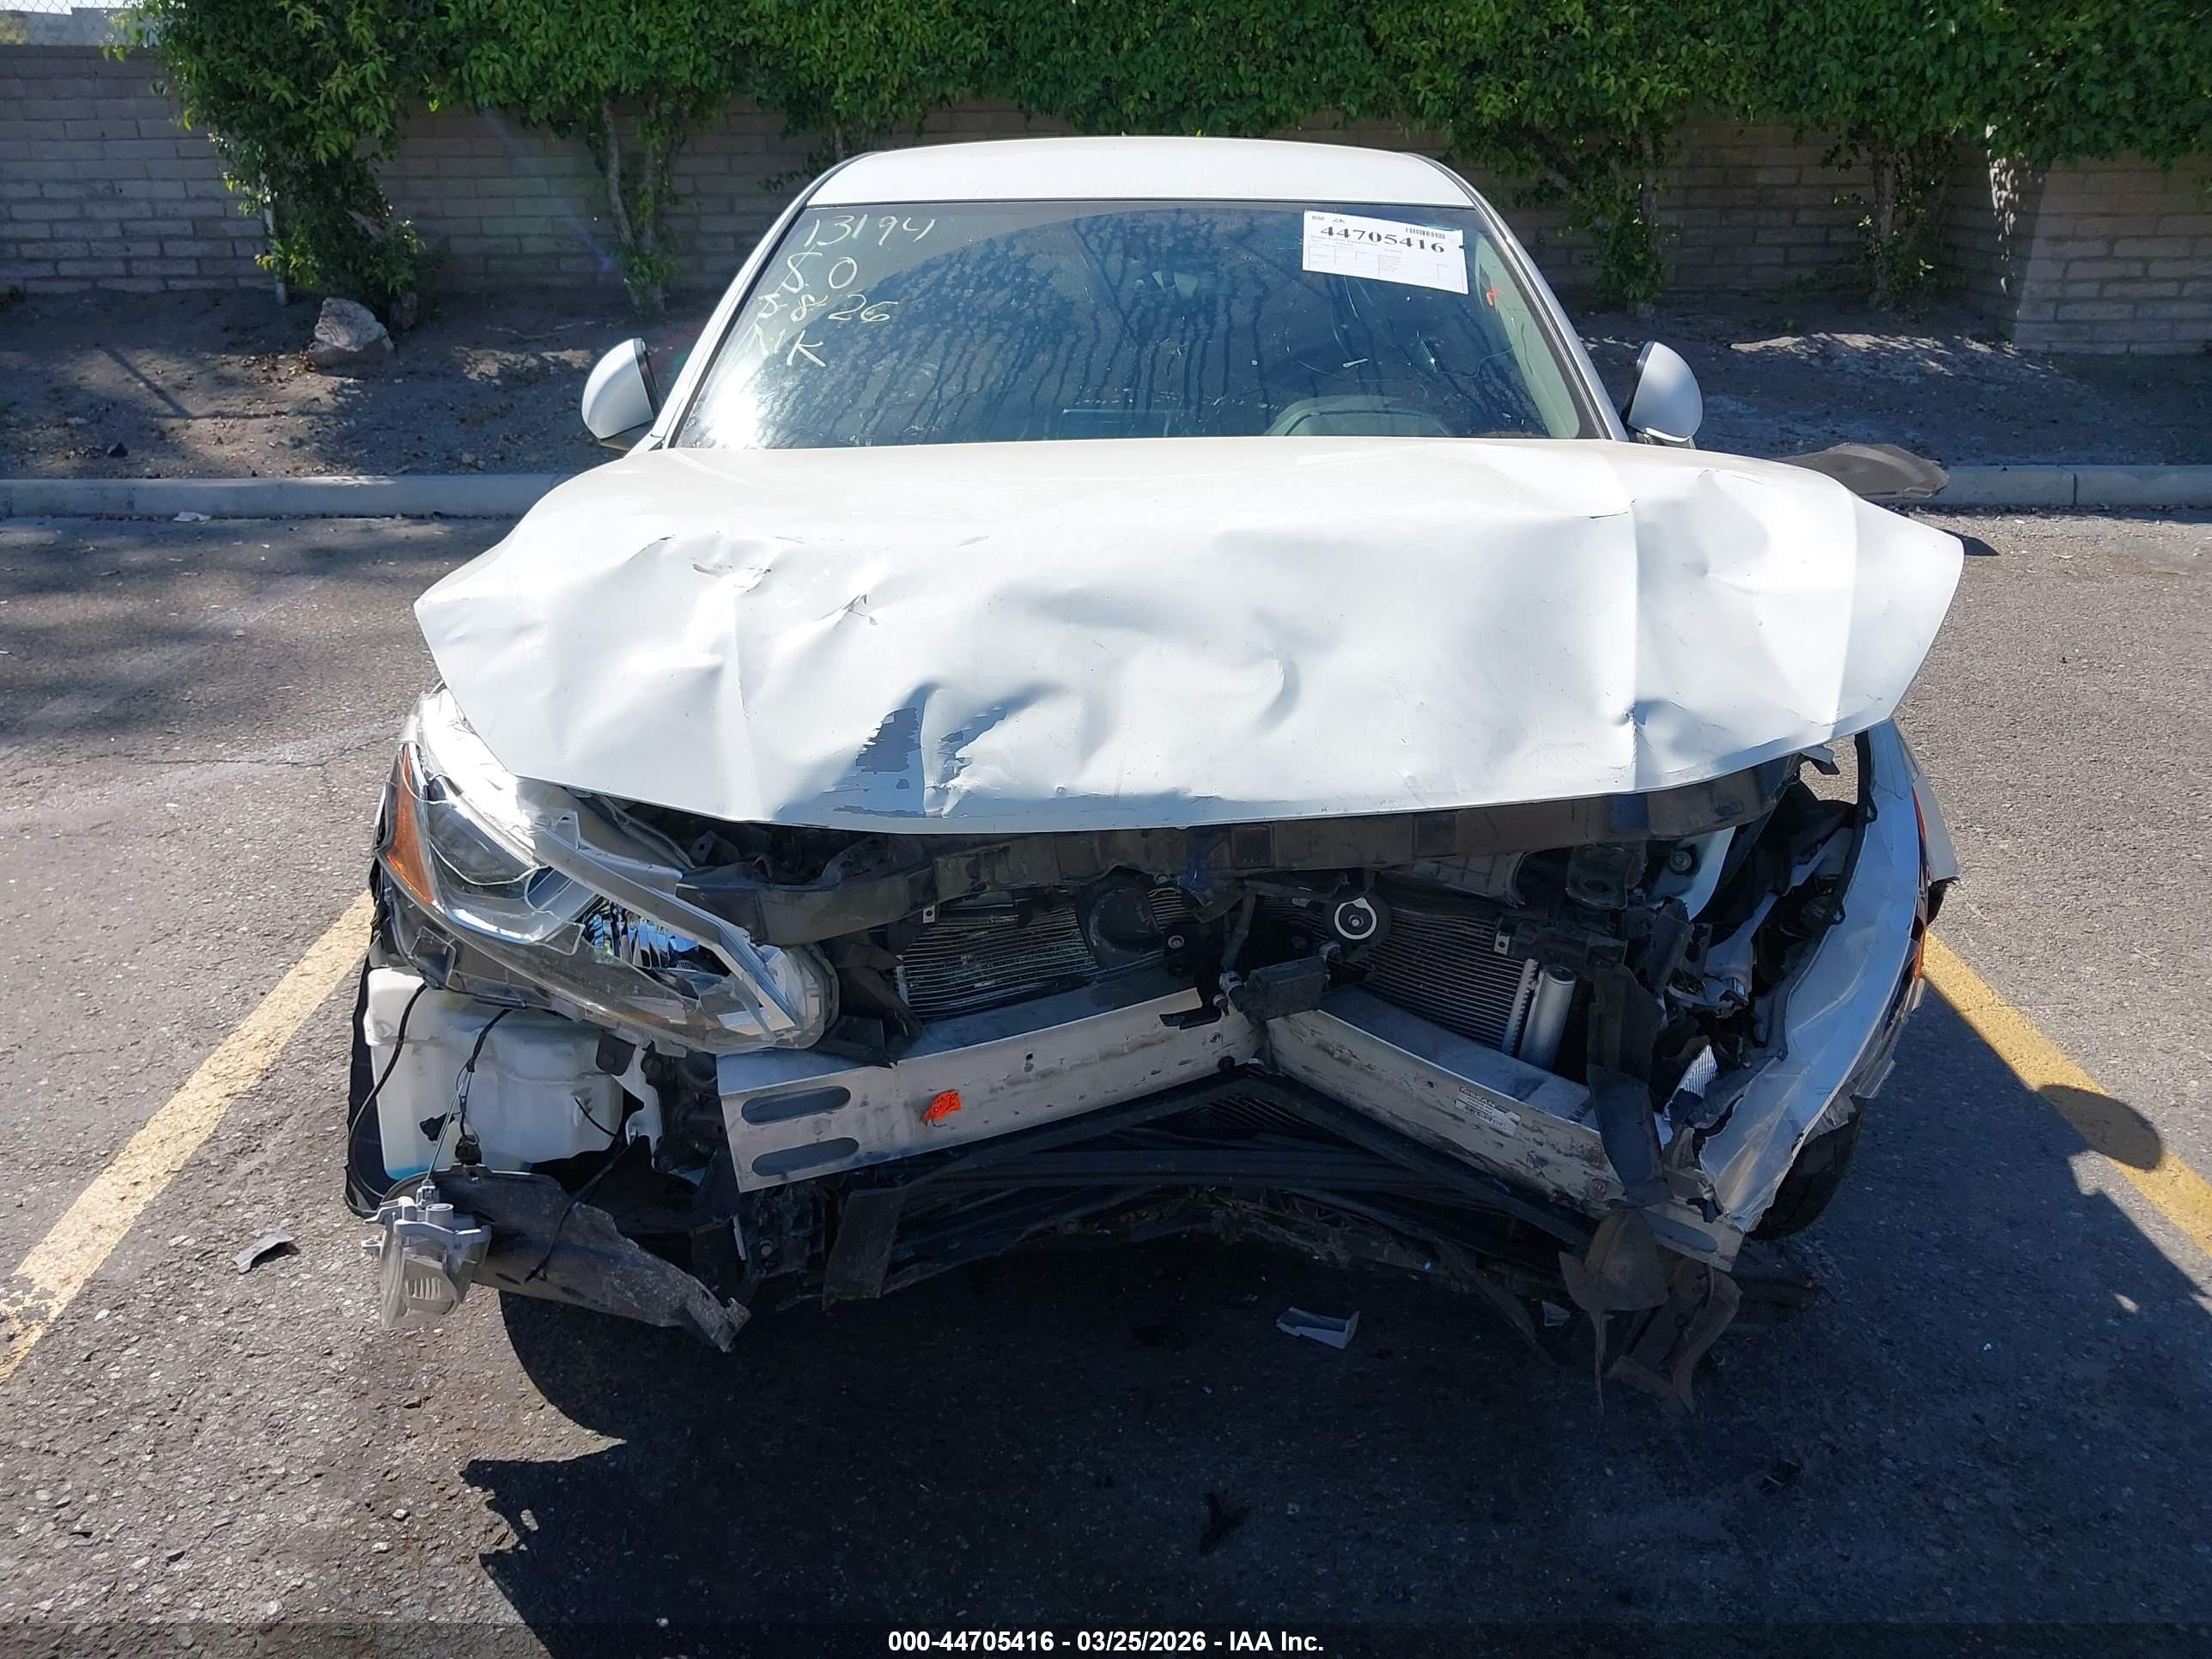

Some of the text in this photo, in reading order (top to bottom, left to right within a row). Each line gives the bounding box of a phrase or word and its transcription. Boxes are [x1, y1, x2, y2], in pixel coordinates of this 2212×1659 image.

[804, 214, 936, 246] 13194
[1320, 226, 1445, 253] 44705416
[1459, 1085, 1496, 1108] NISSAN
